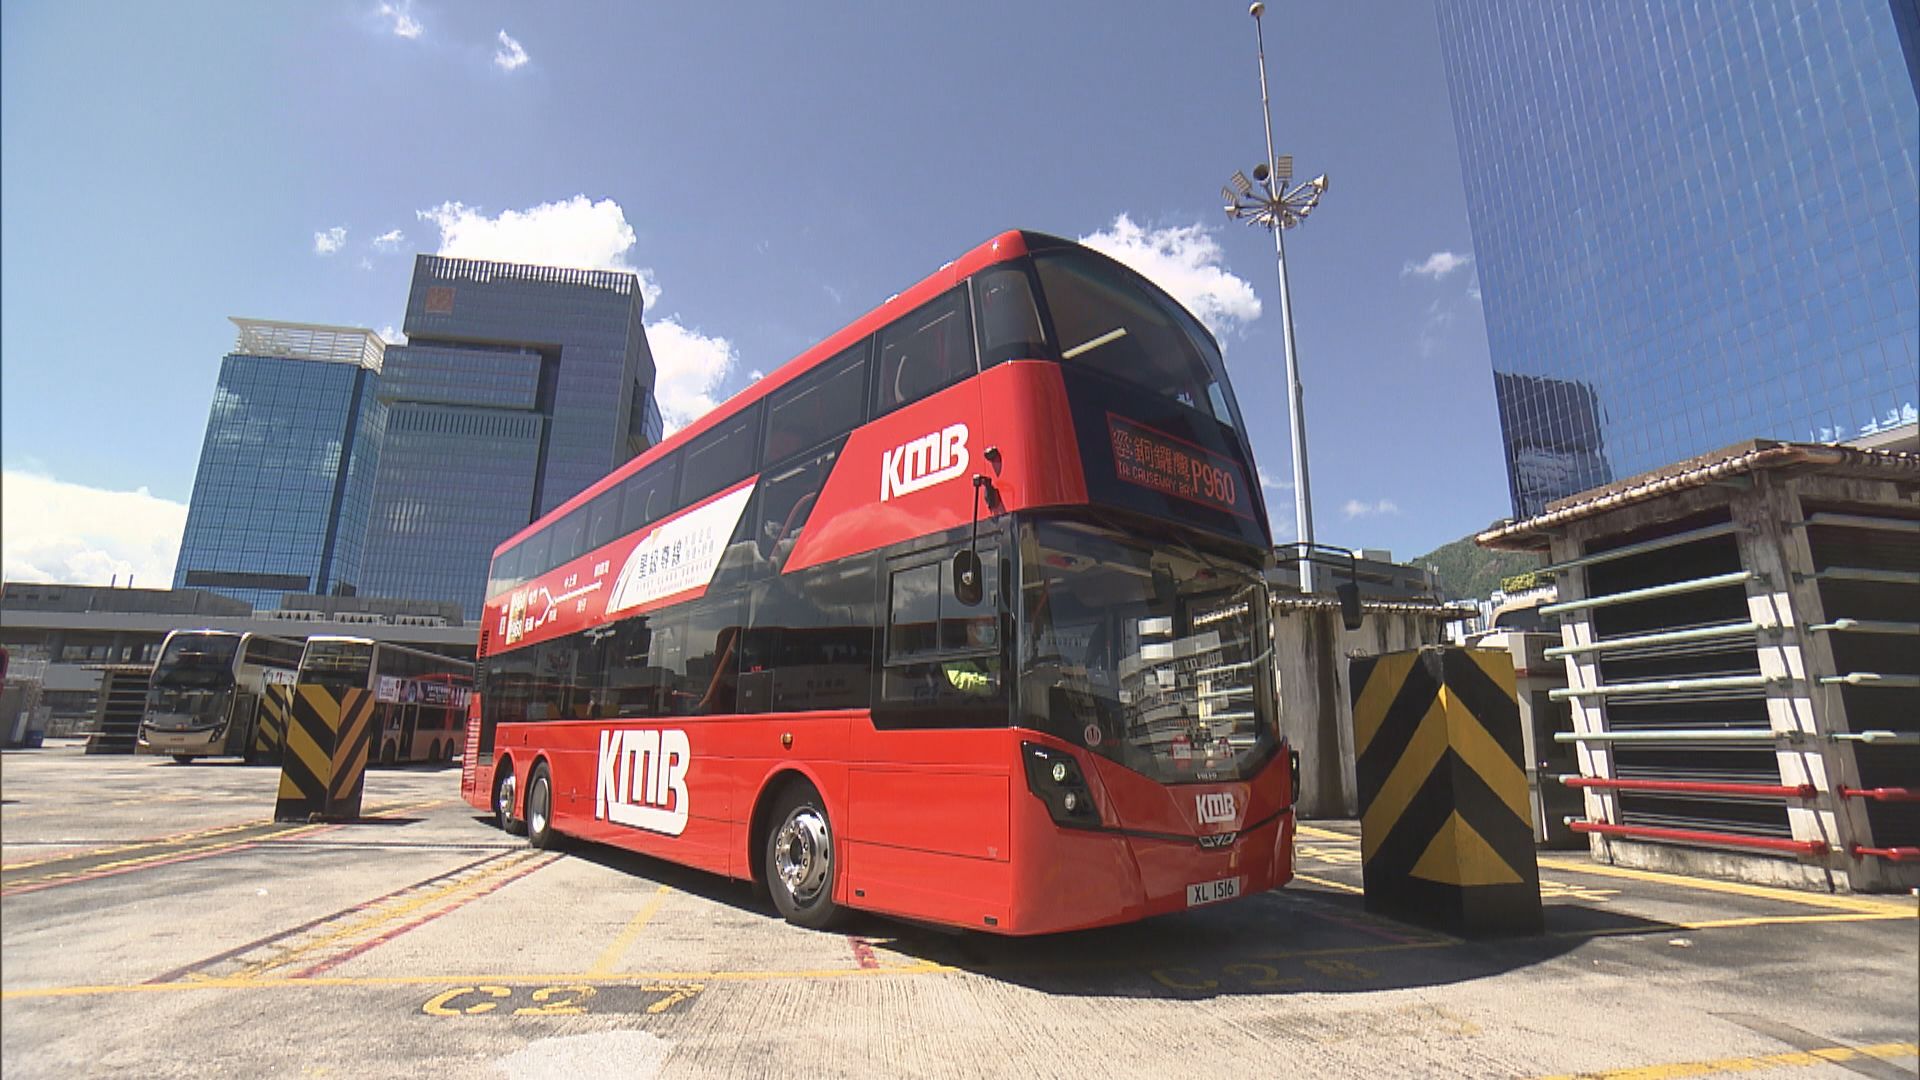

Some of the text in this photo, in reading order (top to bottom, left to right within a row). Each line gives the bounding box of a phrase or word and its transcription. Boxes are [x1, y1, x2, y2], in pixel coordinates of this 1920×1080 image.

[880, 422, 970, 503] KMB
[1192, 458, 1236, 505] P960
[595, 728, 691, 837] KMB
[1195, 791, 1237, 825] KMB
[1194, 879, 1234, 904] XL 1516
